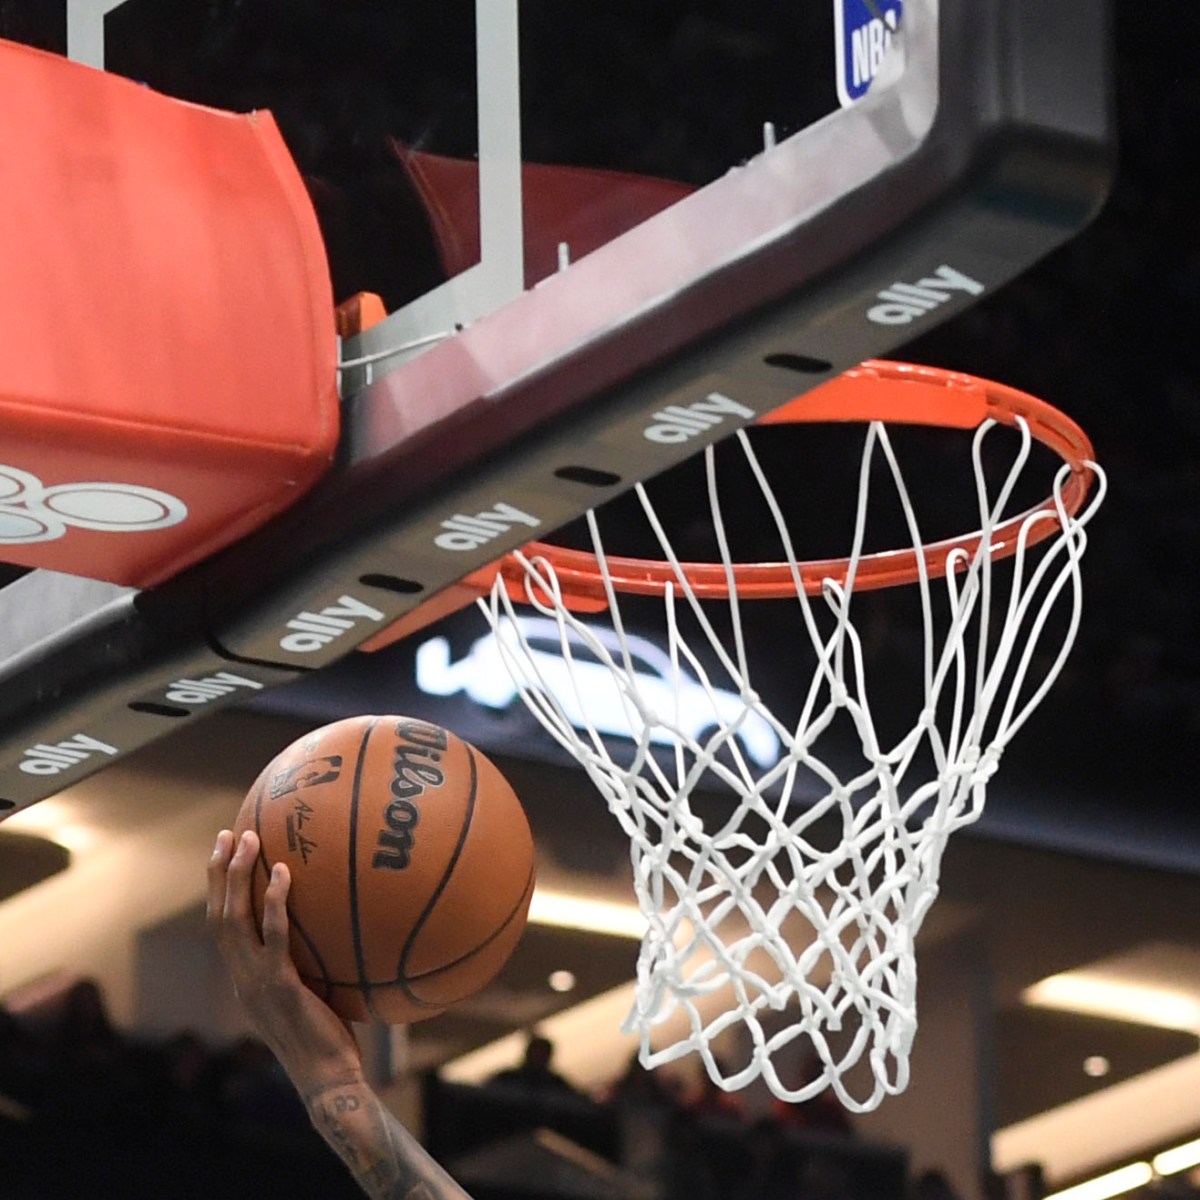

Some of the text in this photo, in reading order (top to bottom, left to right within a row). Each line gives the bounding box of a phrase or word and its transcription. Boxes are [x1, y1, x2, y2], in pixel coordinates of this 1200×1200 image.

[866, 264, 985, 325] ally
[643, 392, 755, 444] ally
[434, 502, 541, 550] ally
[279, 595, 385, 652] ally
[165, 672, 264, 704] ally
[19, 734, 119, 775] ally
[371, 720, 449, 870] Wilson
